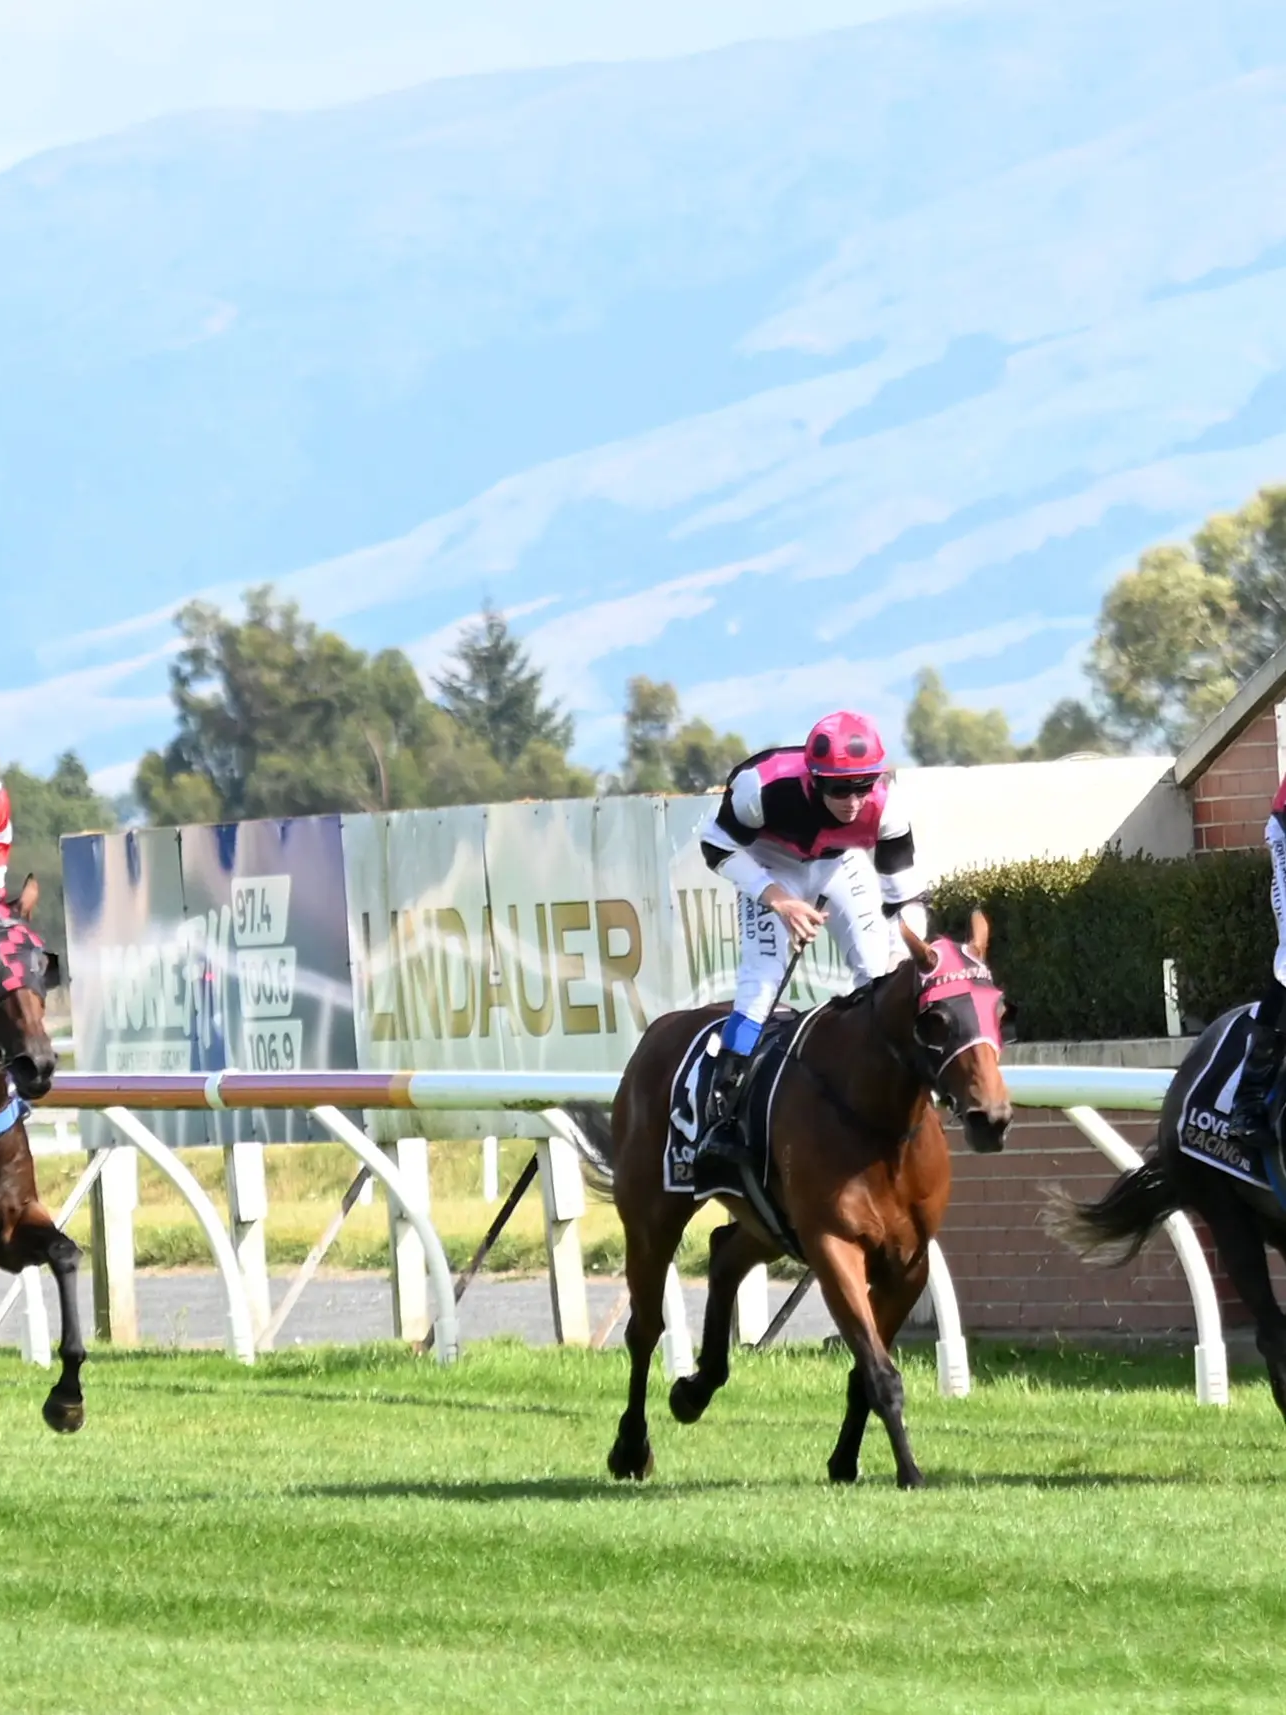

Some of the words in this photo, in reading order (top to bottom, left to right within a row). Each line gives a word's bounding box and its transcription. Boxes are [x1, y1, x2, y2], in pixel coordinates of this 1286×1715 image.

[233, 888, 272, 935] 97.4
[757, 897, 777, 958] ASTI
[241, 957, 291, 1006] 100.6
[361, 898, 649, 1042] LINDAUER
[1184, 1125, 1241, 1165] RACING
[1188, 1107, 1230, 1140] LOVE
